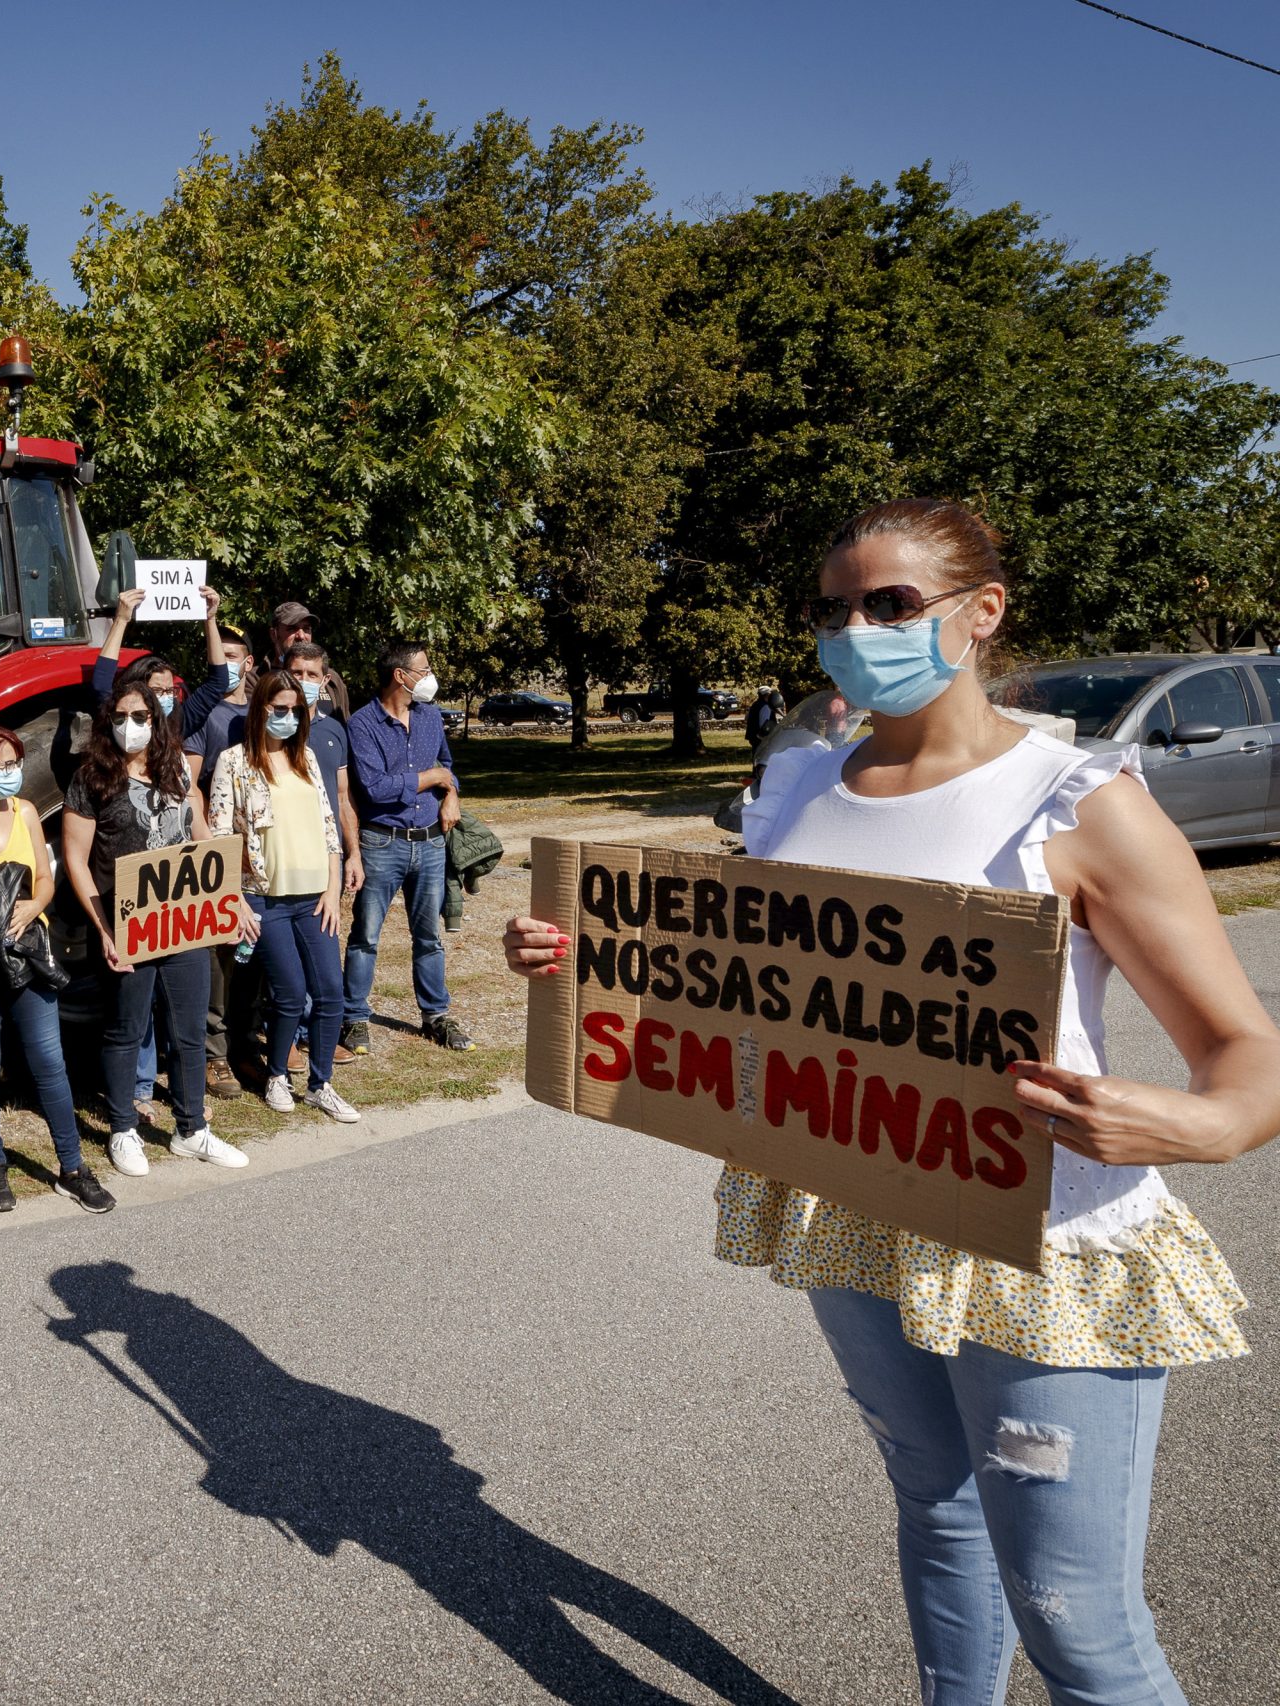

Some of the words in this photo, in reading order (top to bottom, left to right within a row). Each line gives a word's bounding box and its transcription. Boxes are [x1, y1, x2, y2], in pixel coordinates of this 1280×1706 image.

[151, 570, 180, 585] SIM
[184, 566, 193, 585] À
[154, 596, 191, 610] VIDA
[137, 844, 224, 909] NÃO
[581, 864, 907, 966] QUEREMOS
[921, 935, 997, 986] AS
[577, 933, 791, 1022] NOSSAS
[583, 1011, 736, 1111] SEM
